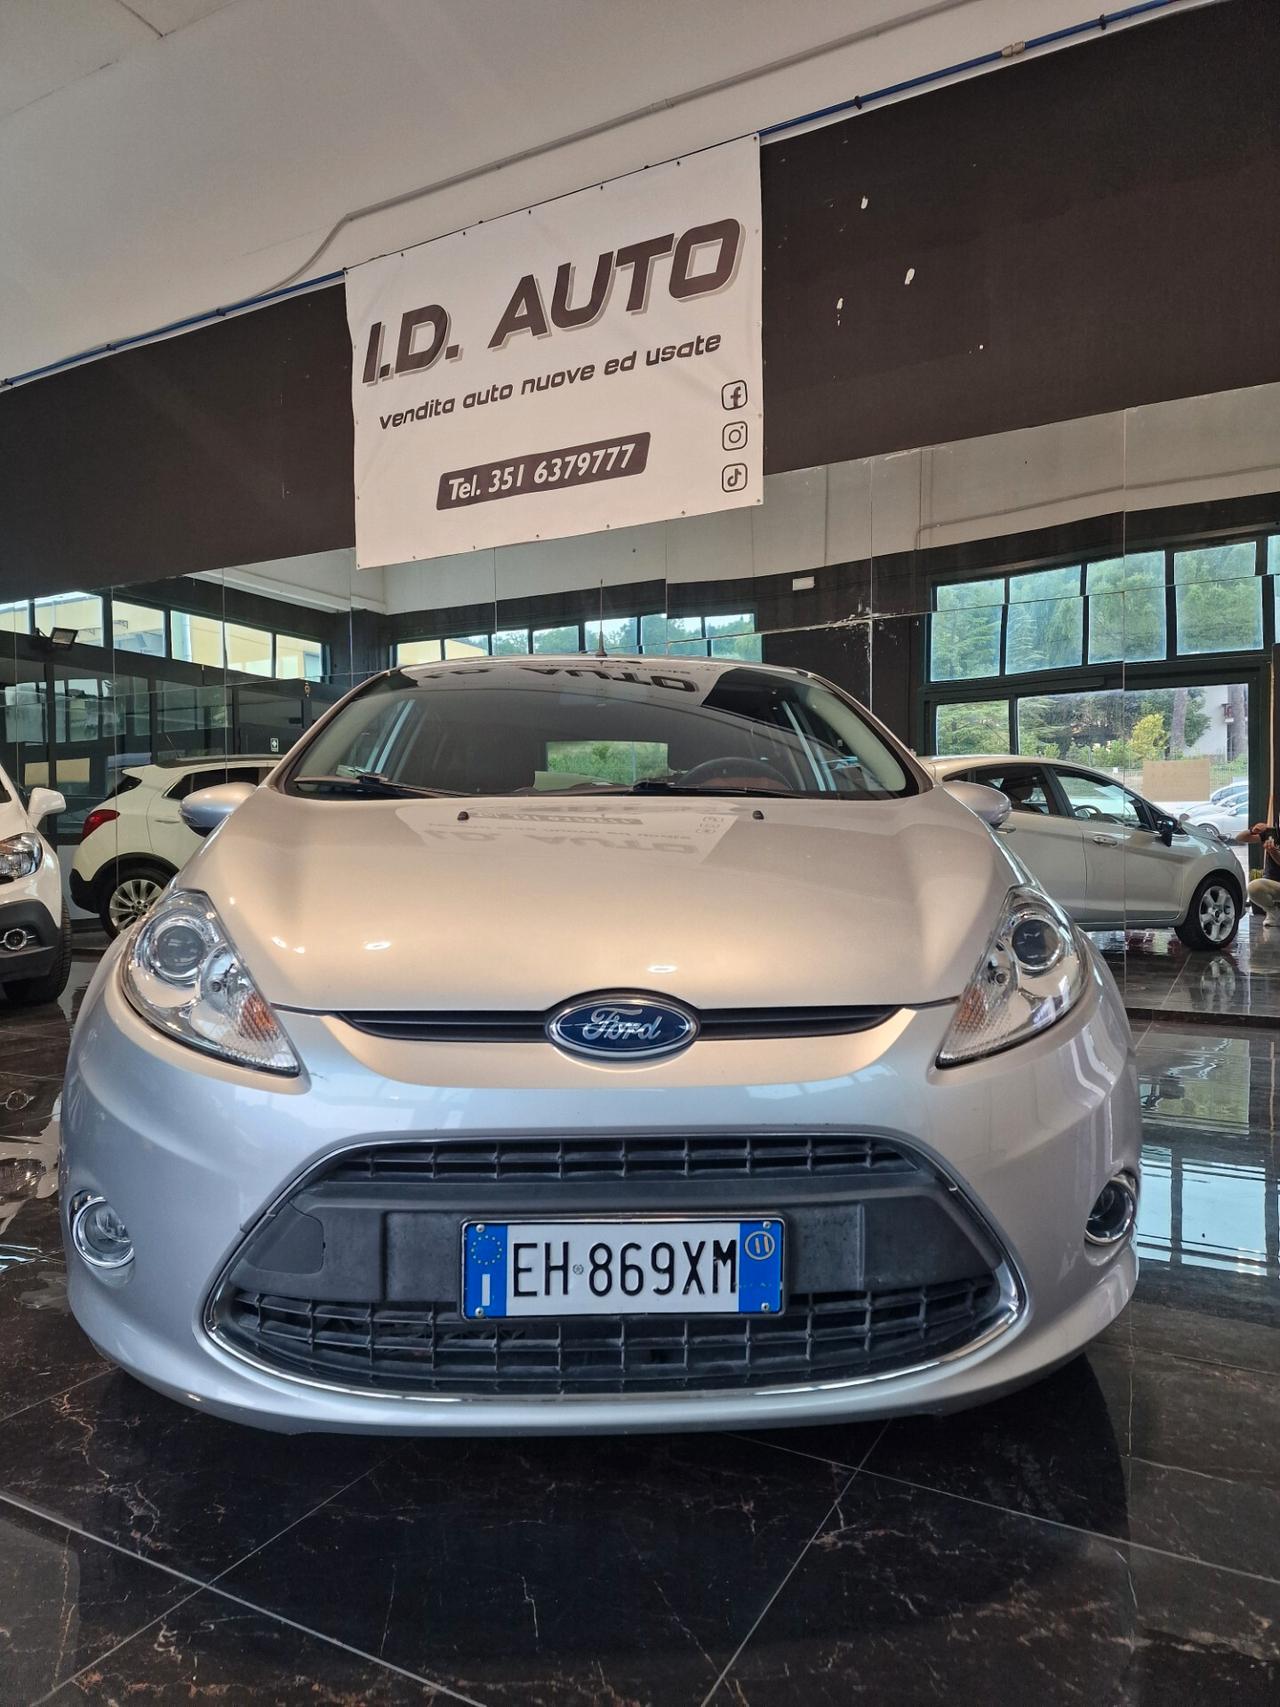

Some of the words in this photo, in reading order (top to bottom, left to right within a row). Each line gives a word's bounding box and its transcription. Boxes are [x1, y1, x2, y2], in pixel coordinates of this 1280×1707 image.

[362, 304, 462, 386] I.D.
[487, 218, 746, 350] AUTO
[379, 397, 454, 430] vendita
[462, 382, 513, 409] auto
[521, 364, 595, 396] nuove
[603, 350, 635, 376] ed
[646, 333, 721, 366] usate
[448, 476, 481, 501] Tel.
[488, 464, 525, 493] 351
[533, 443, 636, 485] 6379777
[582, 1007, 662, 1040] Ford
